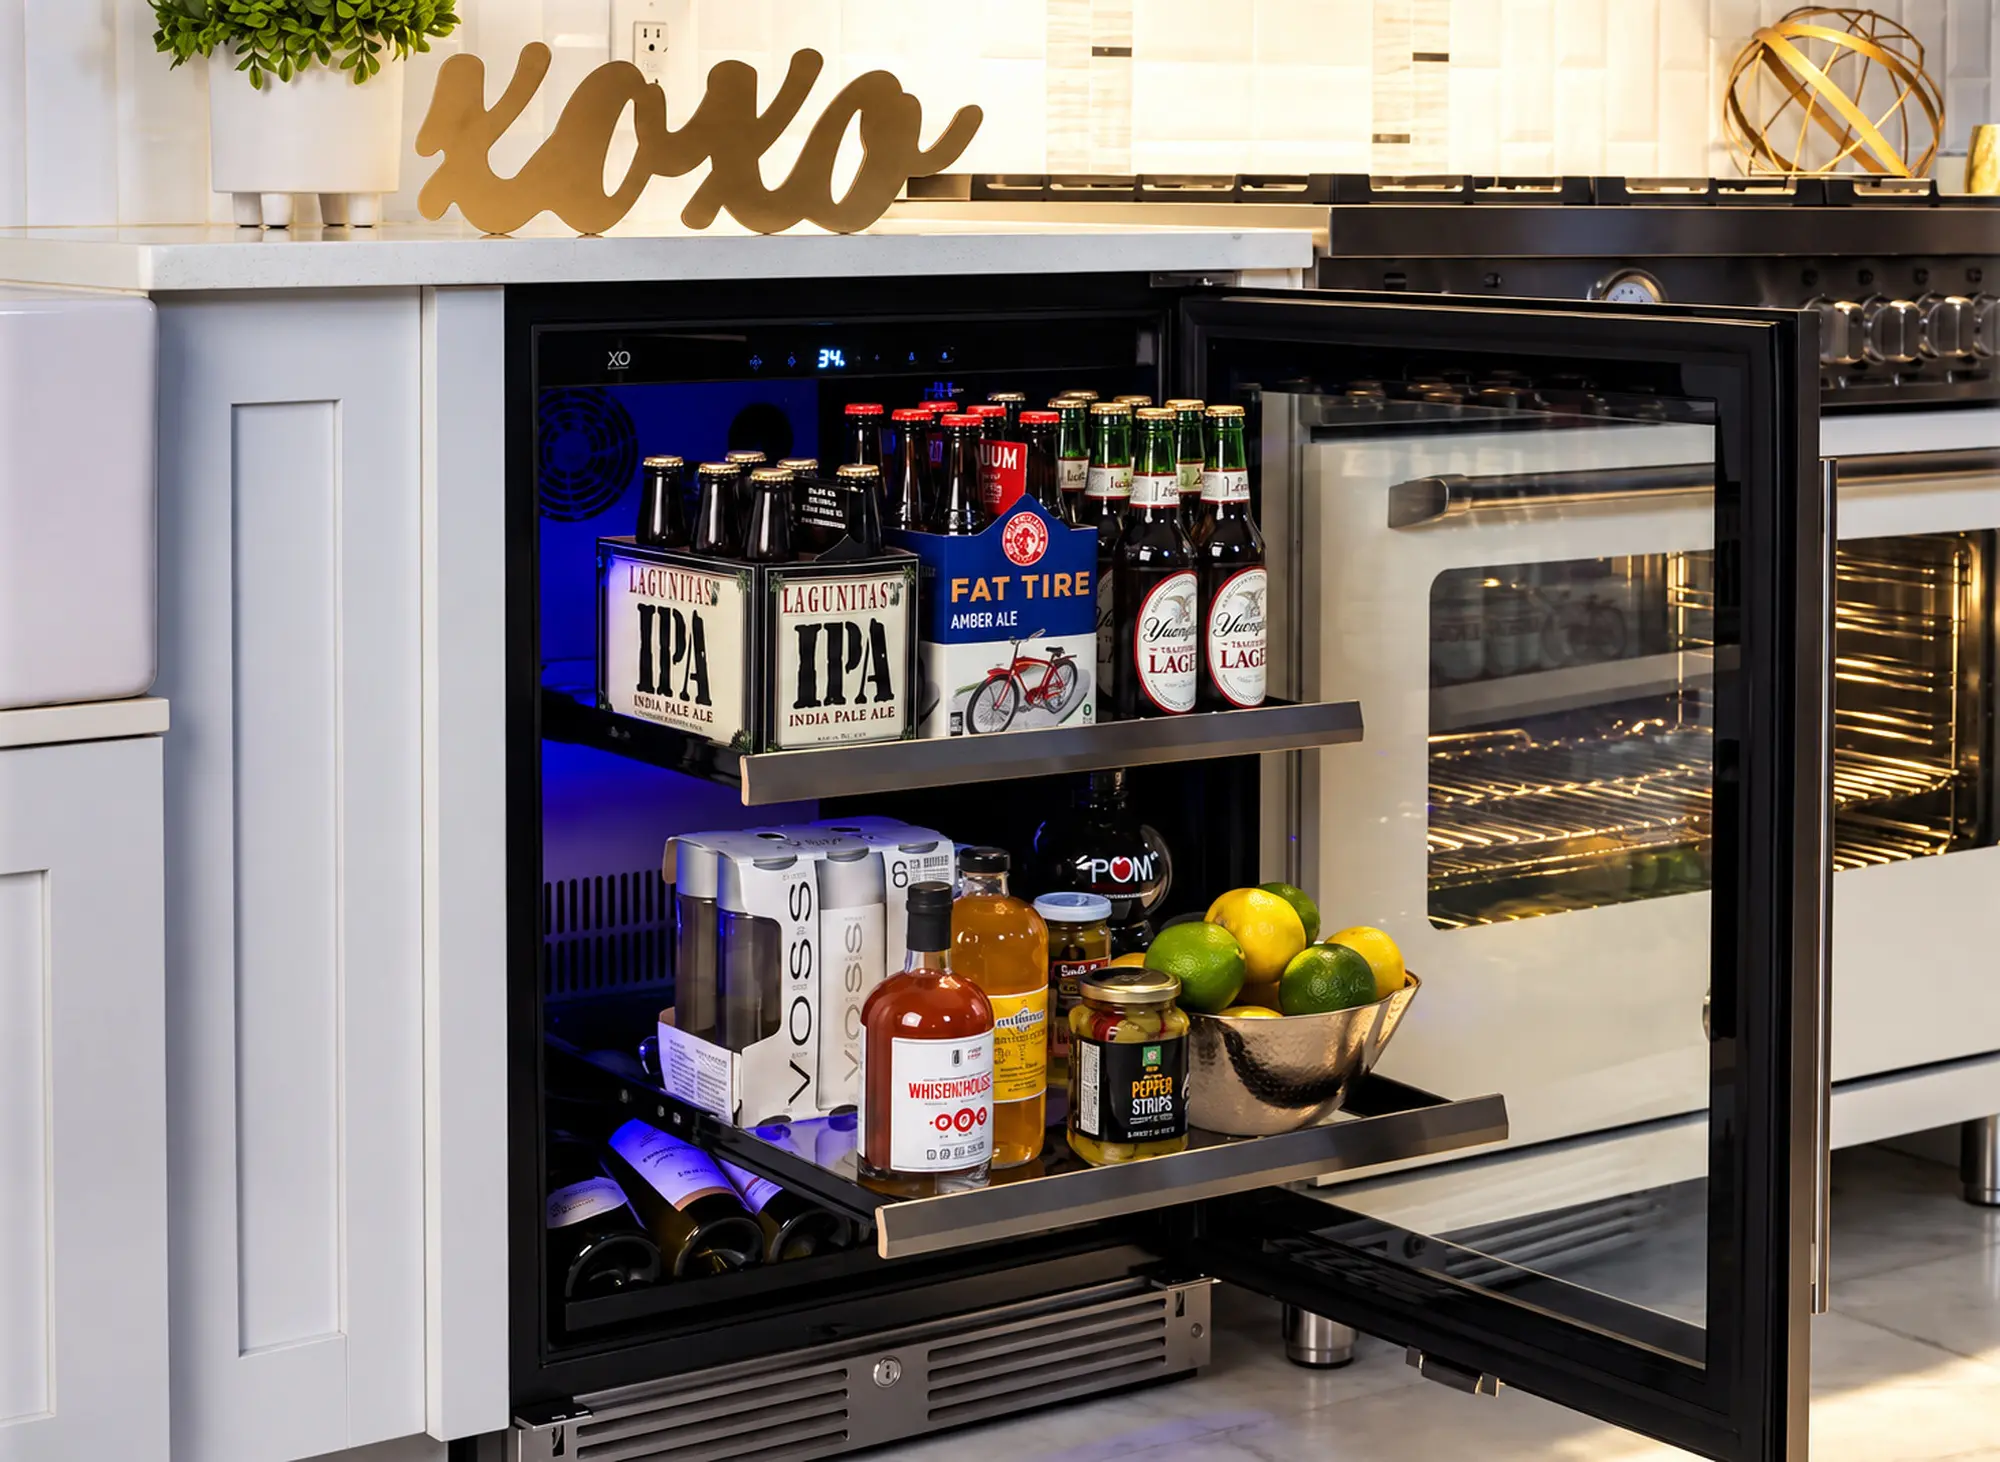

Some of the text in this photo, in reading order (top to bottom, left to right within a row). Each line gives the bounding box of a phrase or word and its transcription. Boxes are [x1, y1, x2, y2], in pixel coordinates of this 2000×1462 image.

[607, 350, 631, 366] XO
[629, 565, 713, 606] LAGUNITAS
[783, 581, 889, 614] LAGUNITAS
[951, 571, 1090, 603] FAT TIRE
[951, 610, 1018, 630] AMBER ALE
[636, 602, 712, 707] IPA
[792, 617, 895, 710] IPA
[1148, 652, 1197, 674] LAGE
[1220, 647, 1266, 669] LAGE
[633, 694, 662, 713] INDIA
[665, 701, 689, 717] PALE
[692, 708, 713, 723] ALE
[789, 706, 895, 727] INDIA PALE ALE
[892, 860, 909, 889] 6
[1091, 855, 1153, 883] POM
[787, 880, 812, 1105] VOSS
[844, 923, 863, 1082] VOSS
[1131, 1076, 1173, 1099] PEPPER
[1132, 1094, 1173, 1116] STRIPS
